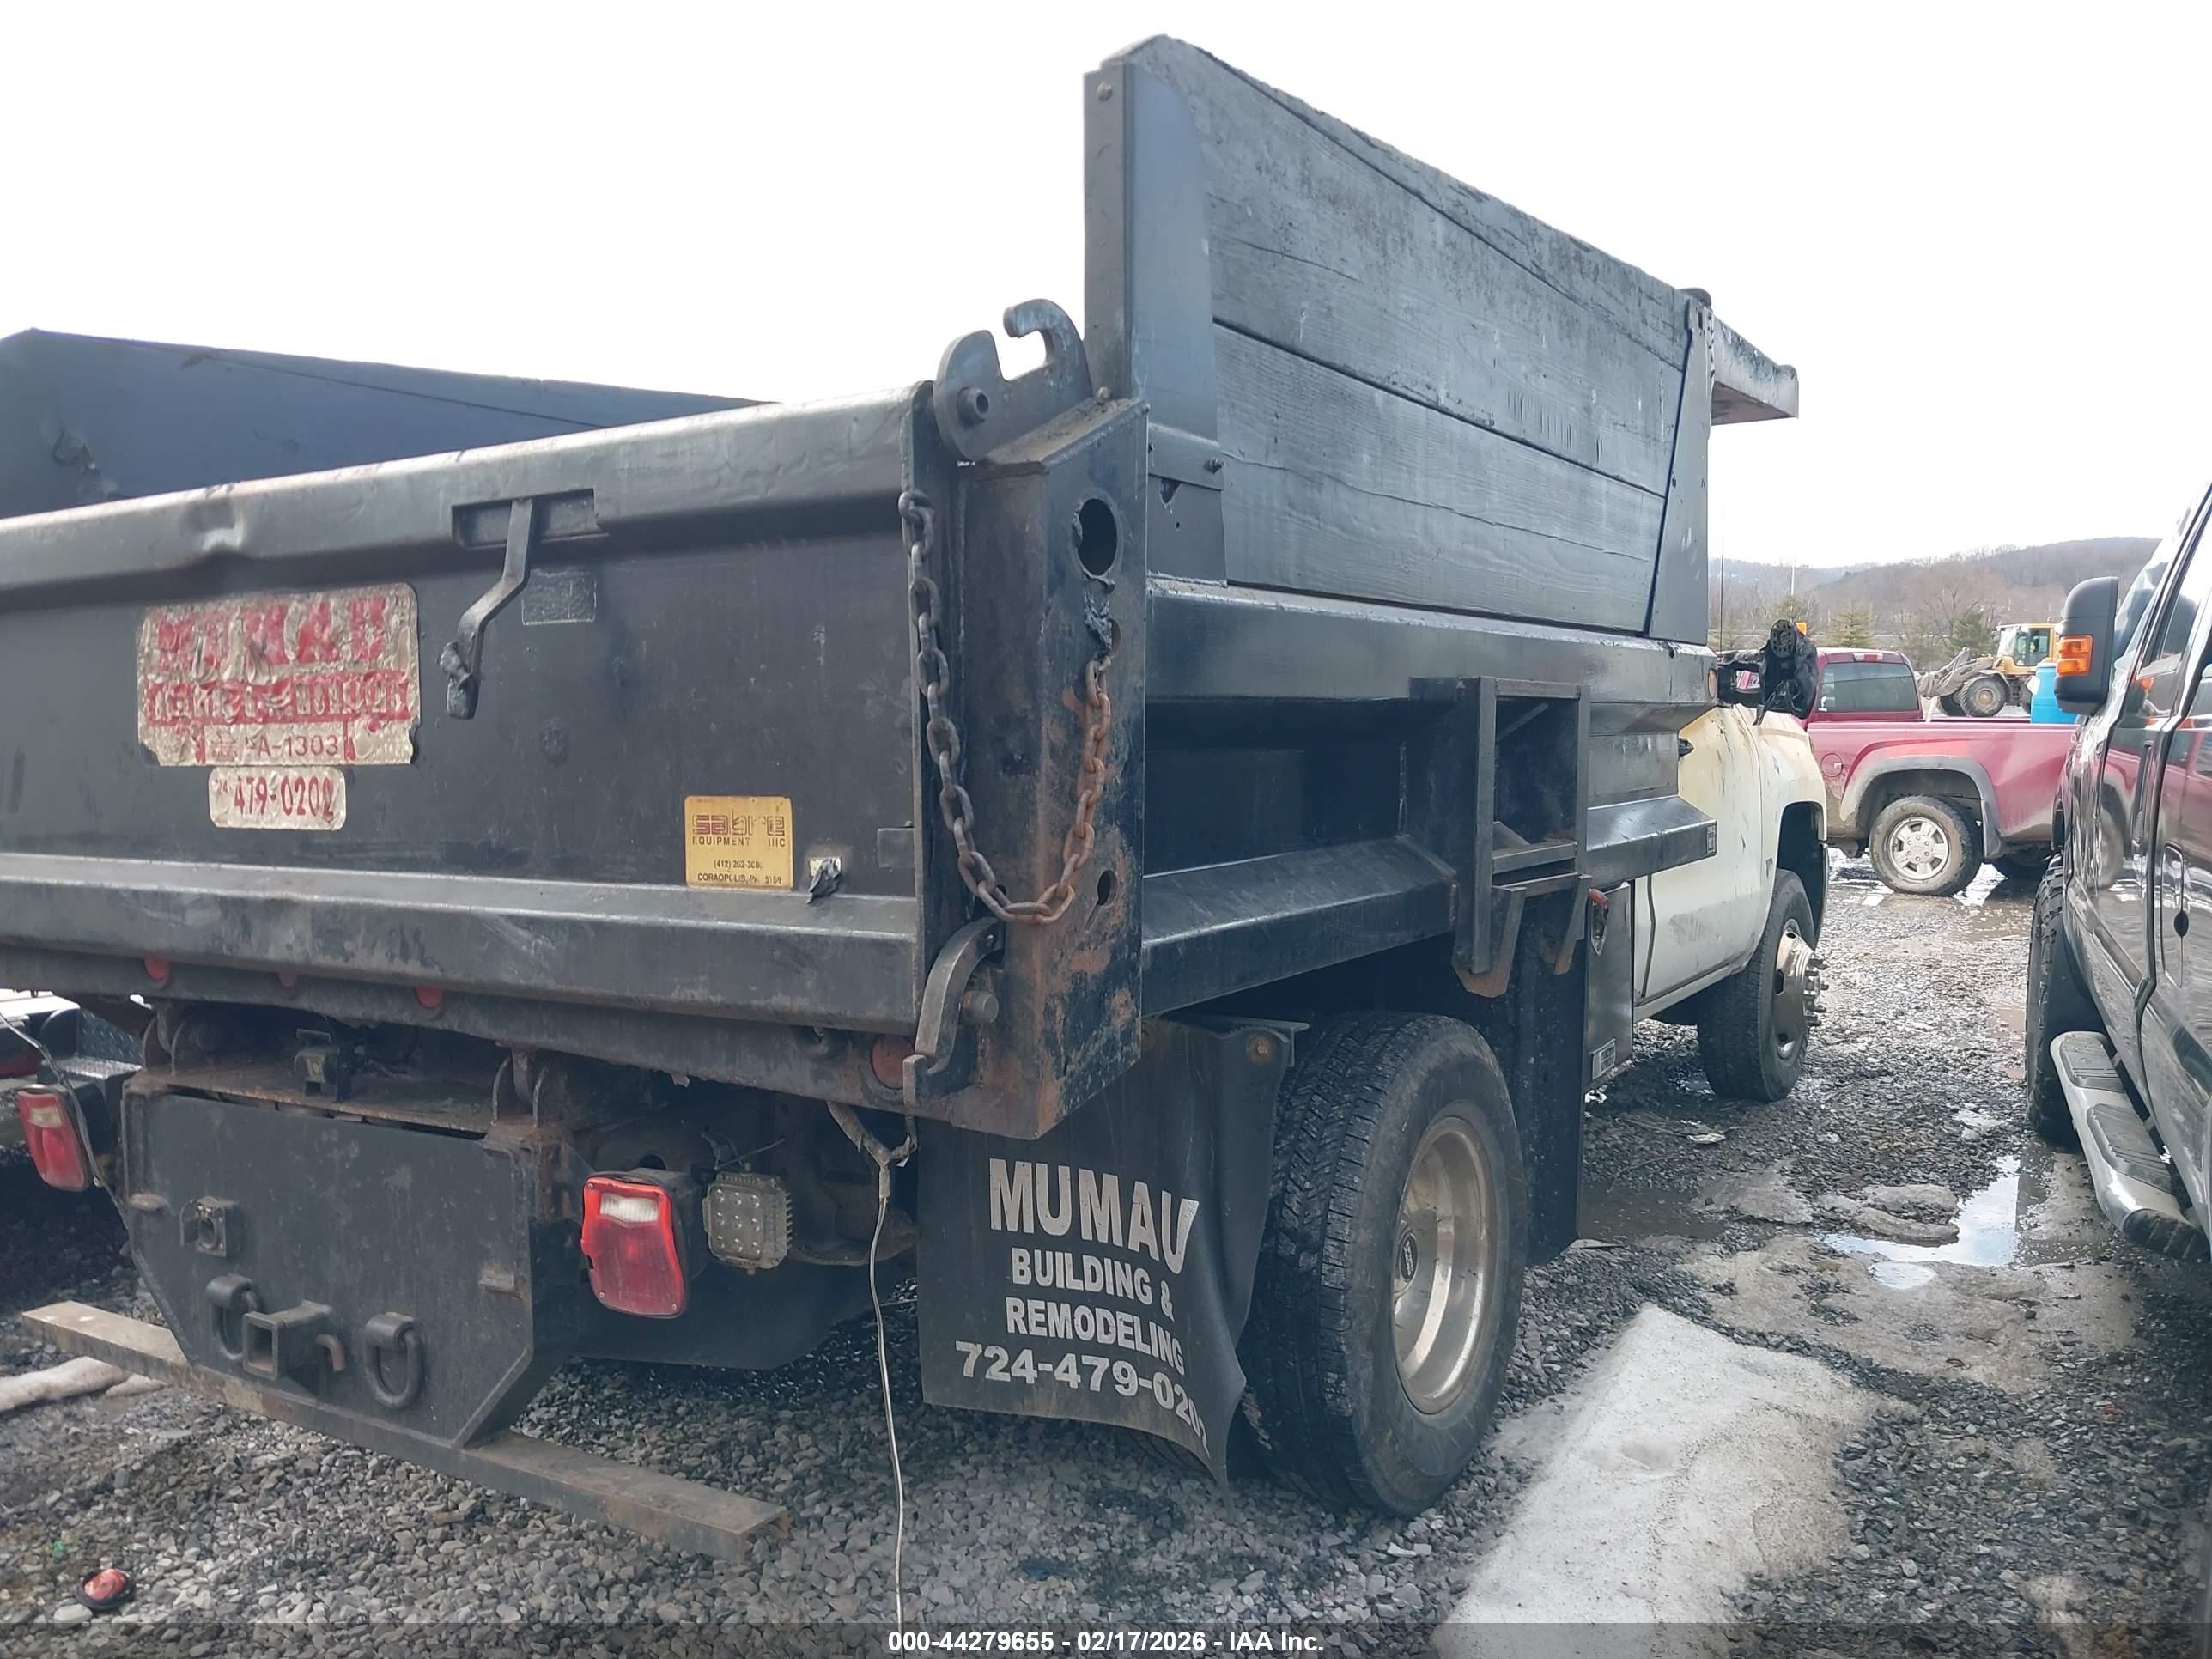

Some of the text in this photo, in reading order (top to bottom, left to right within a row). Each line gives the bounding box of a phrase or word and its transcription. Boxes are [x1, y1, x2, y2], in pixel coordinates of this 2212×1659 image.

[714, 860, 731, 869] (412)
[990, 1158, 1200, 1274] MUMAU
[1012, 1247, 1176, 1322] BUILDING &
[1006, 1297, 1185, 1376] REMODELING
